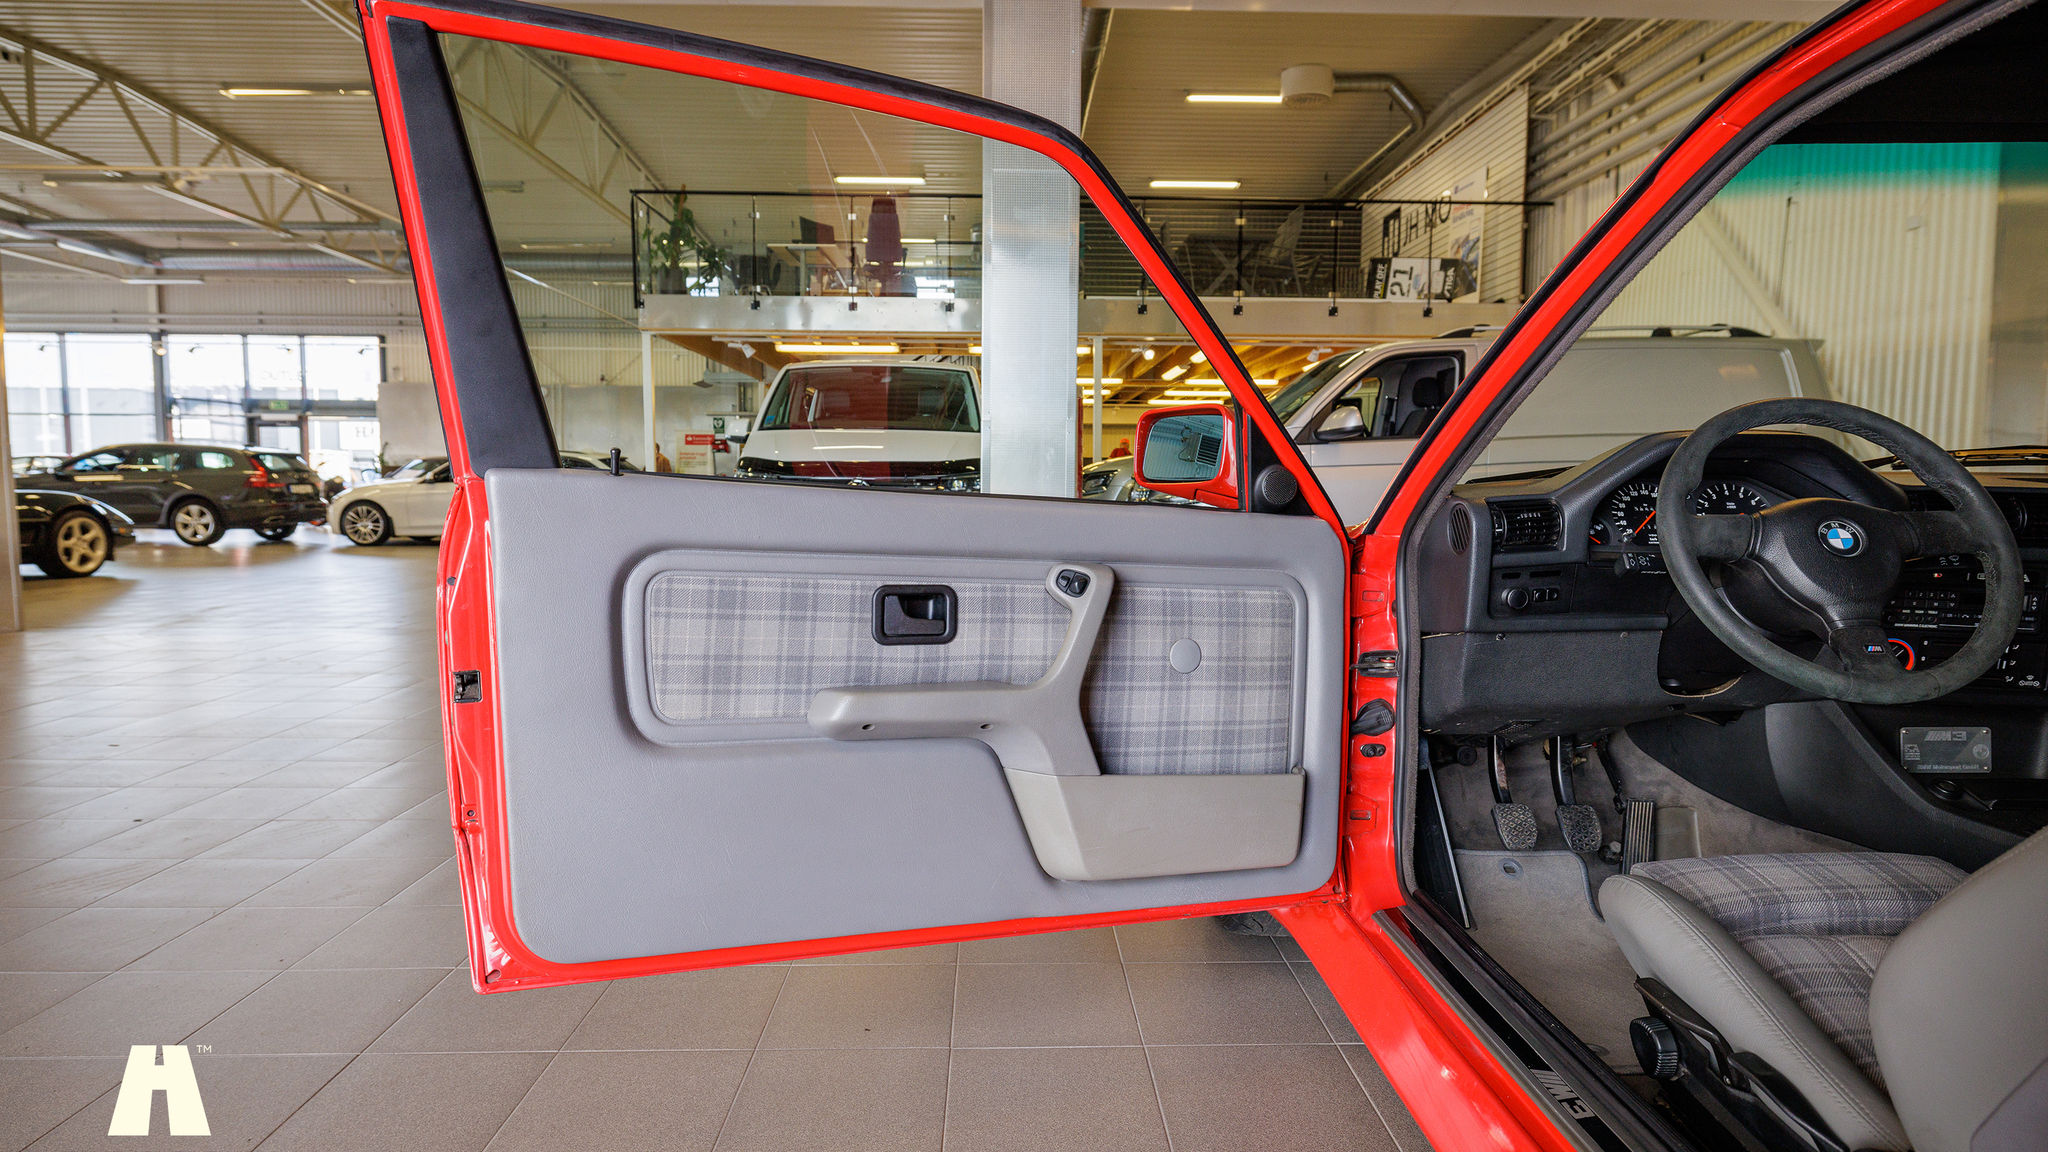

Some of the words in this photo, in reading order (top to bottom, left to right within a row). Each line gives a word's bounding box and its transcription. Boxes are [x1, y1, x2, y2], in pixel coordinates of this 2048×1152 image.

[1376, 263, 1387, 280] OFF
[1390, 266, 1413, 297] 21
[1373, 279, 1384, 299] PLAY
[1820, 522, 1855, 535] BMW
[1536, 1075, 1595, 1120] M3
